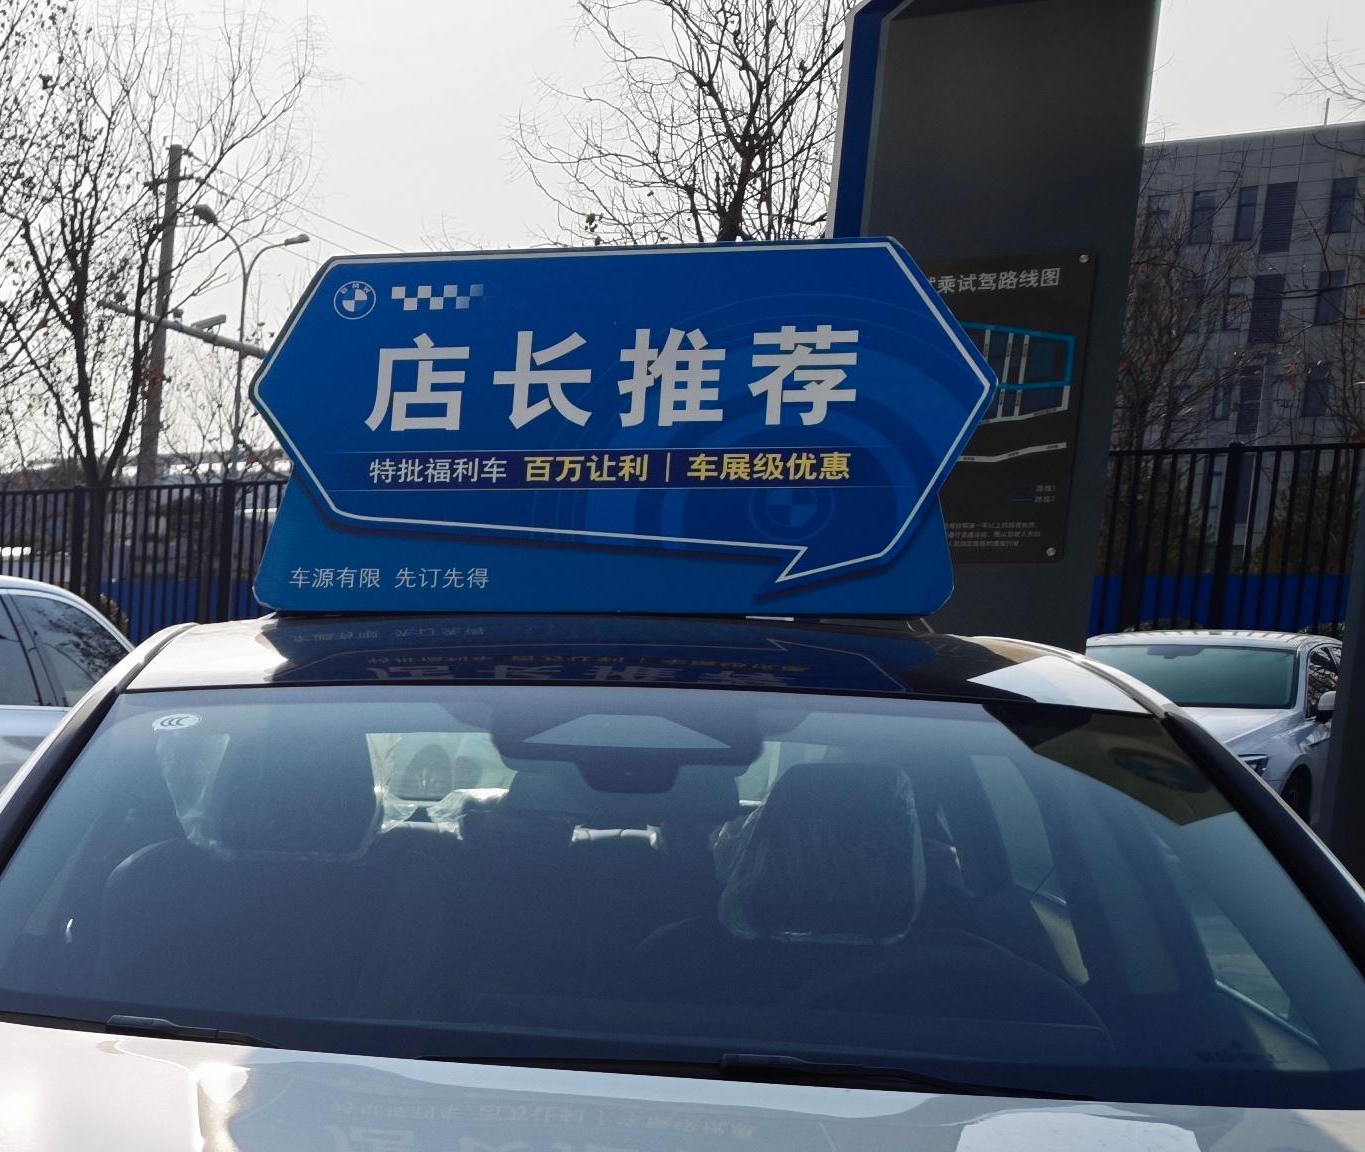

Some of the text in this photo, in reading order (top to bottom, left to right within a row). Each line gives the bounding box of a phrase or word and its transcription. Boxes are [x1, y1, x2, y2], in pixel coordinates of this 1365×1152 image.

[928, 267, 1061, 294] 乘试驾路线图
[365, 324, 860, 432] 店长推荐
[368, 451, 851, 484] 特批福利车 百万让利 车展级优惠
[288, 567, 490, 589] 车源有限 先订先得
